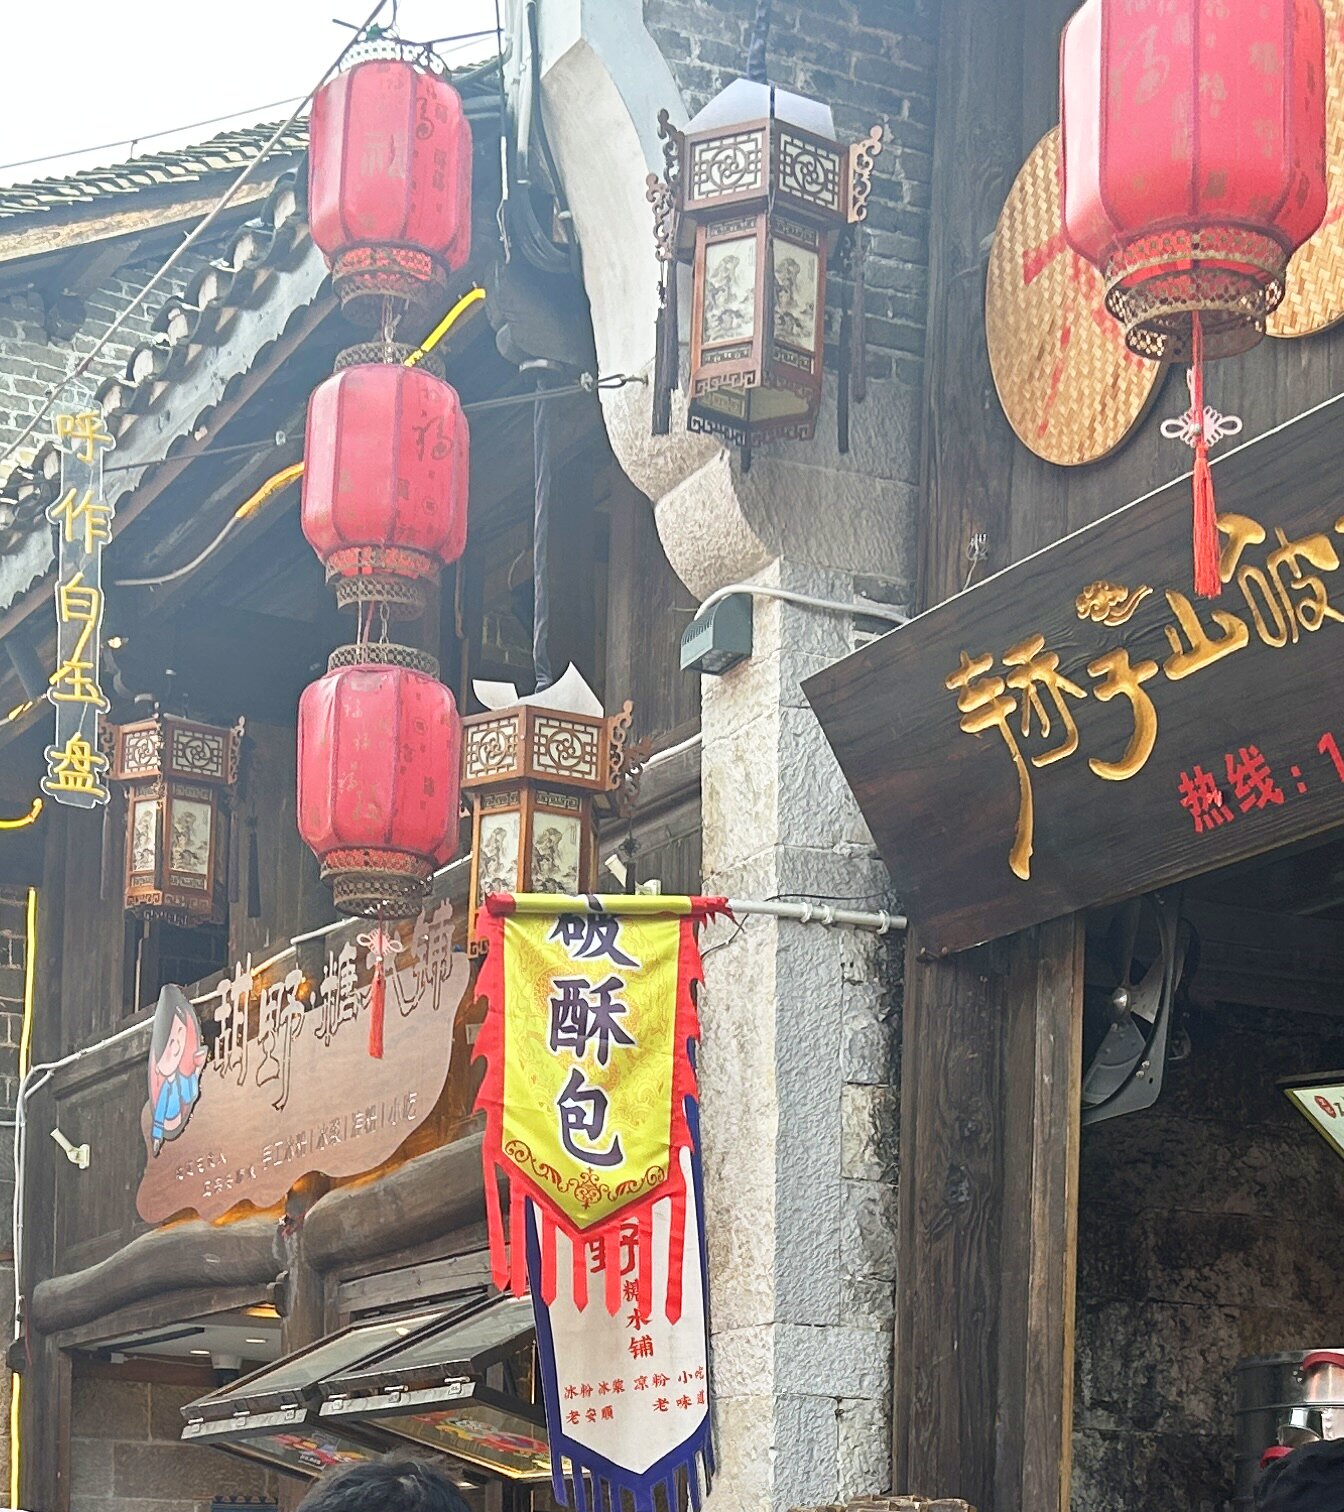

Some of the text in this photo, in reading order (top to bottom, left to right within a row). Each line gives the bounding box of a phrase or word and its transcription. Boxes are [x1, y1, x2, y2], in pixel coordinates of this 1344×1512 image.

[49, 408, 112, 797] 呼作白玉盘
[549, 895, 639, 1167] 破酥包
